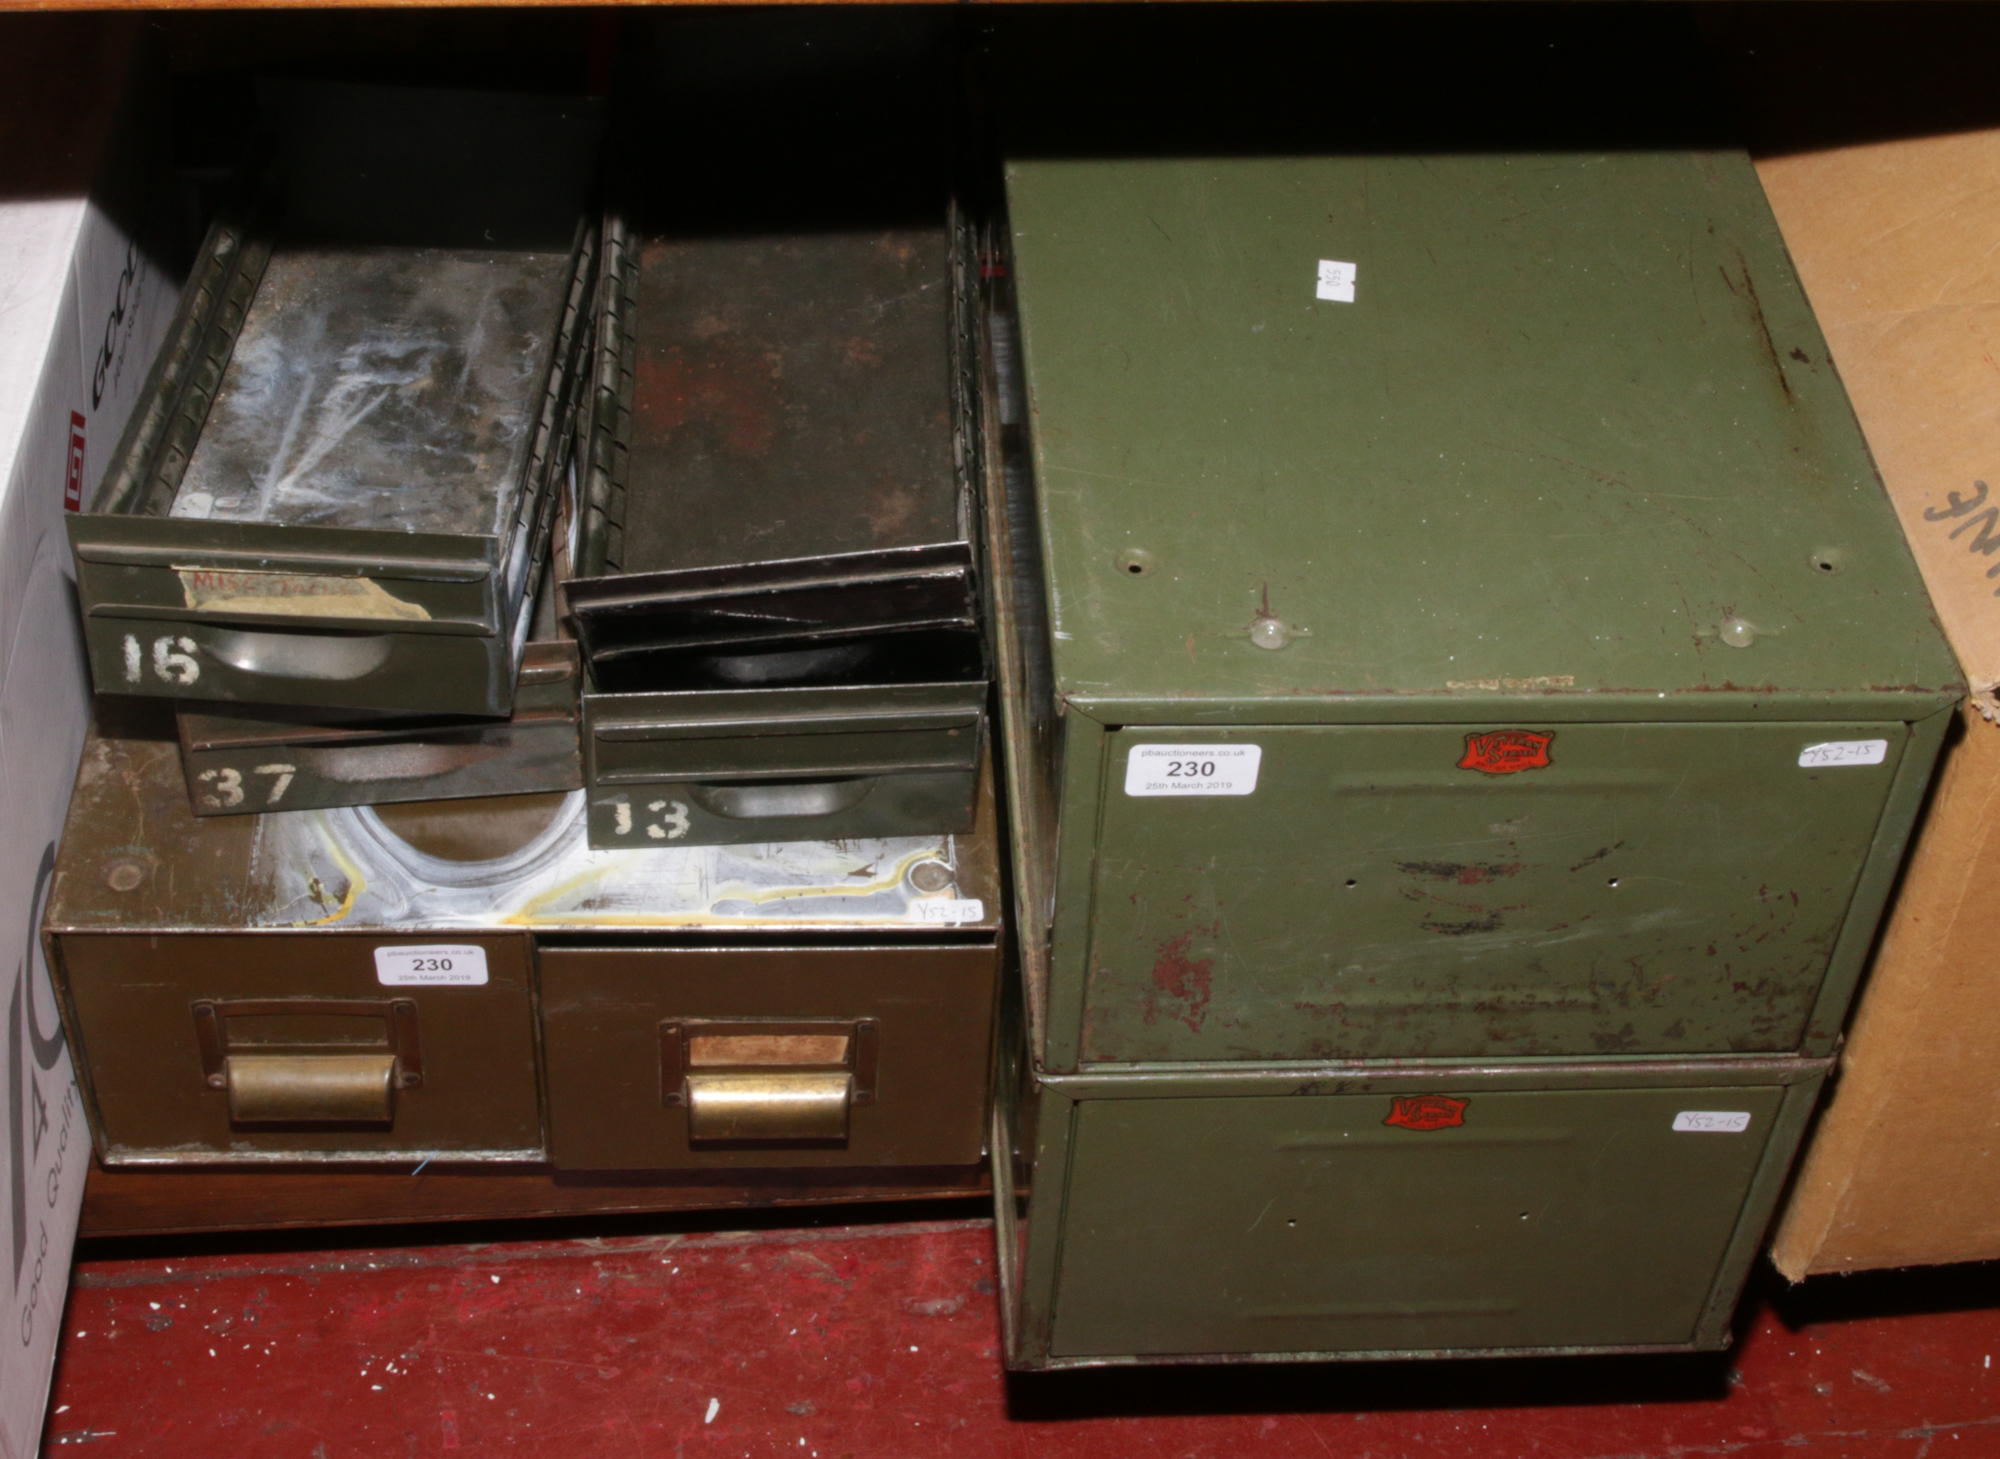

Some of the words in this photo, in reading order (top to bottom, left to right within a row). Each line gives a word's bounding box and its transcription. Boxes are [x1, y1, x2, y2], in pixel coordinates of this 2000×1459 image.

[193, 571, 257, 591] MISC
[122, 633, 200, 686] 16
[1140, 749, 1246, 758] pbauctioneers.co.uk
[1165, 761, 1215, 777] 230
[198, 763, 297, 808] 37
[1145, 782, 1168, 790] 25th
[1171, 781, 1203, 790] March
[1206, 781, 1232, 789] 2019
[592, 792, 692, 839] 13
[387, 948, 474, 957] pbauctioneers.co.uk
[412, 958, 453, 971] 230
[21, 1220, 48, 1347] Good
